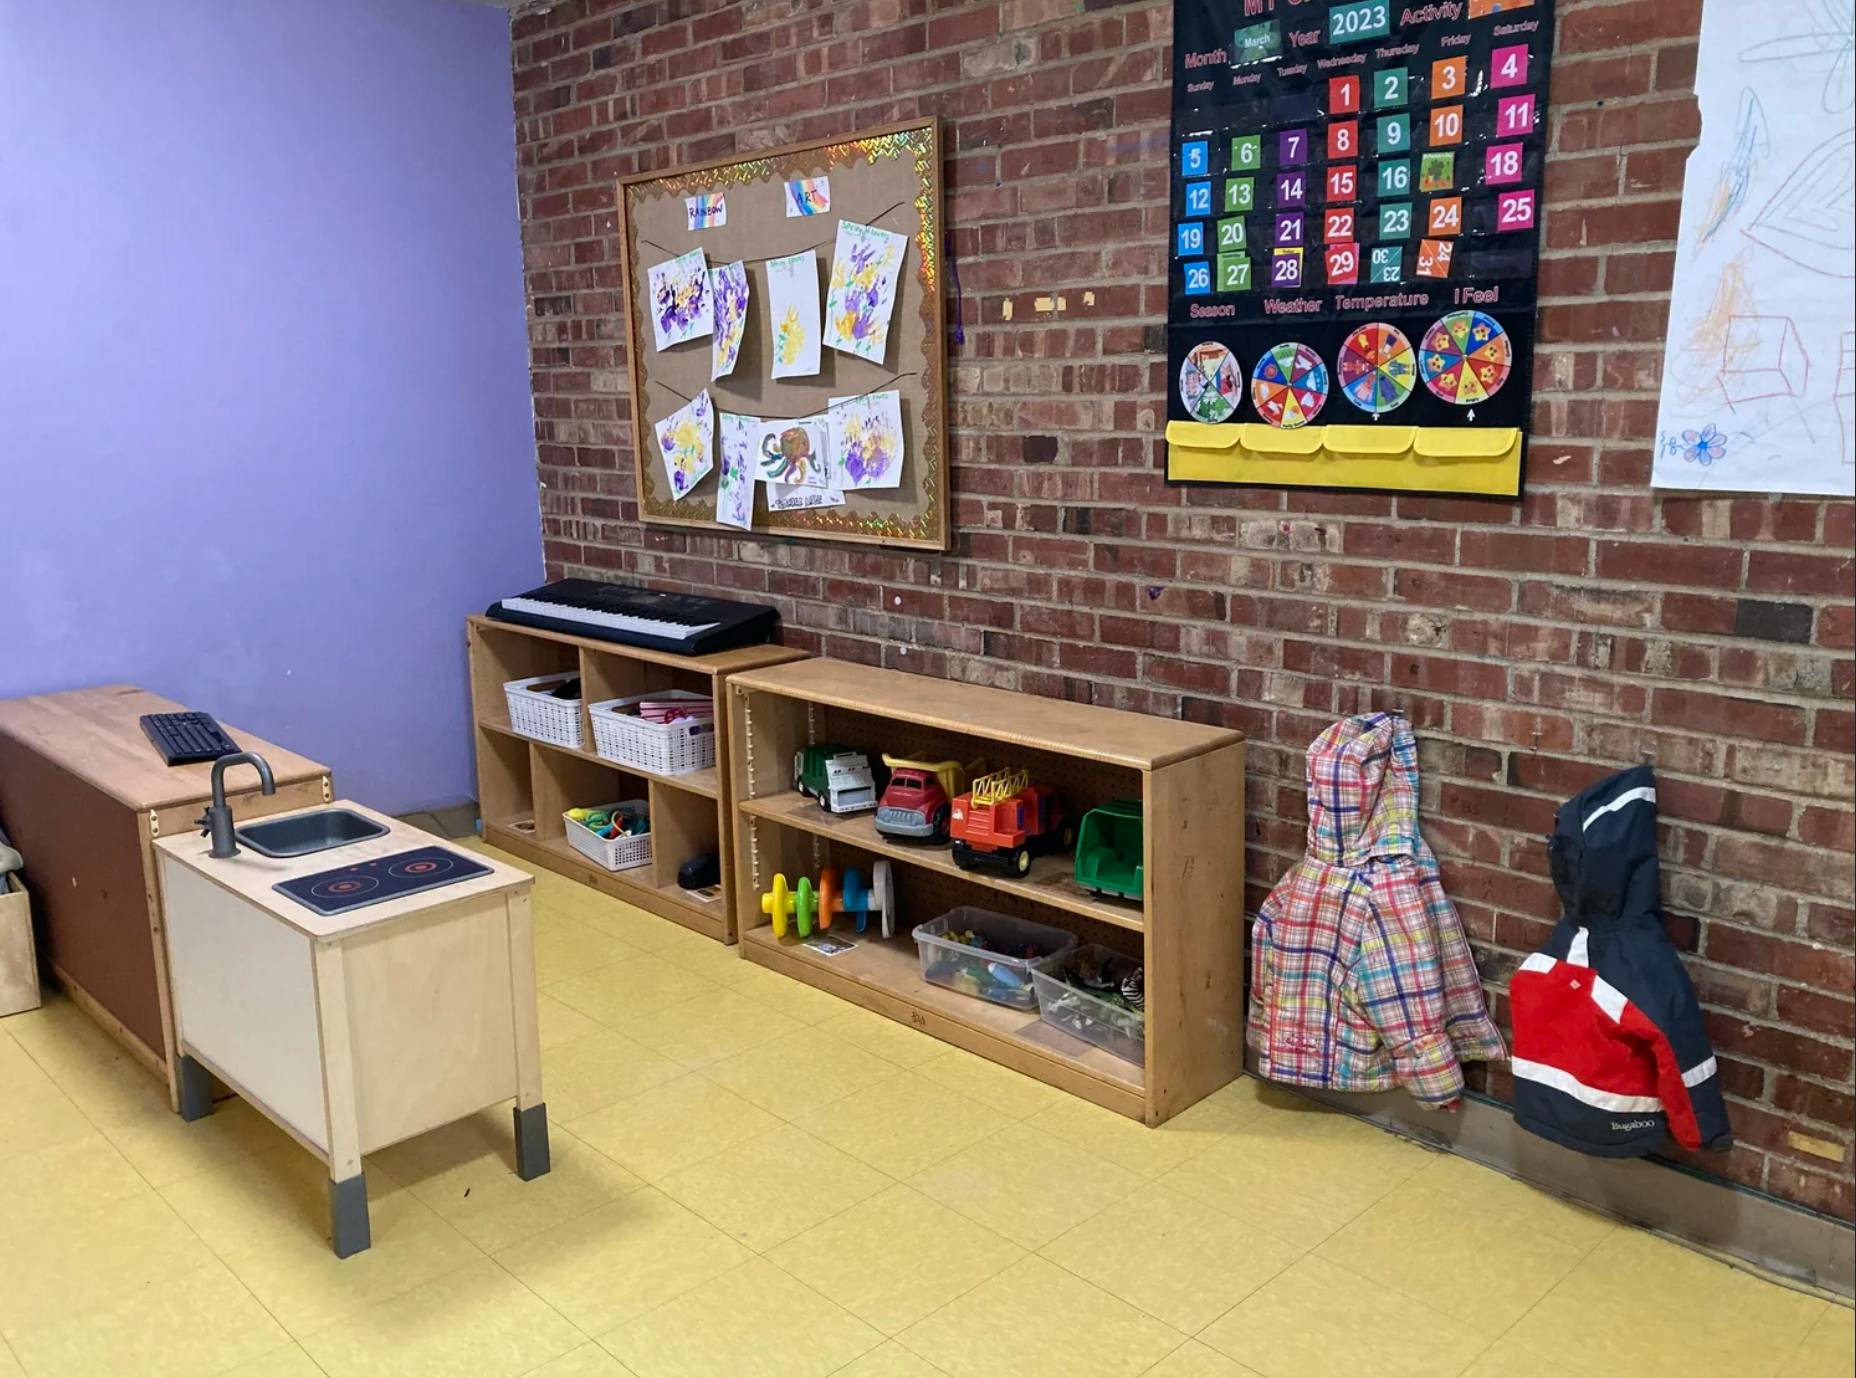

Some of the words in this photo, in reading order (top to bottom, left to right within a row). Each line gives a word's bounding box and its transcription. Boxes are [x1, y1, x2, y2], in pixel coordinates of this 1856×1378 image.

[1332, 6, 1386, 36] 2023
[1400, 2, 1463, 26] Activity
[1244, 34, 1271, 47] March
[1289, 30, 1321, 47] Year
[1185, 49, 1228, 69] Month
[1187, 80, 1215, 93] Sunday
[1232, 72, 1262, 86] Monday
[1277, 63, 1308, 77] Tuesday
[1316, 51, 1367, 70] Wednesday
[1375, 43, 1420, 59] Thursday
[1440, 33, 1472, 47] Friday
[1493, 20, 1539, 37] Saturday
[1340, 83, 1350, 106] 1
[1384, 76, 1399, 101] 2
[1442, 65, 1457, 91] 3
[1500, 53, 1518, 79] 4
[1189, 148, 1202, 169] 5
[1240, 143, 1253, 164] 6
[1288, 136, 1300, 159] 7
[1337, 129, 1350, 151] 8
[1387, 122, 1401, 145] 9
[1434, 112, 1459, 138] 10
[1505, 102, 1529, 129] 11
[1189, 188, 1209, 210] 12
[1228, 184, 1250, 205] 13
[1280, 178, 1303, 201] 14
[1330, 172, 1354, 195] 15
[1382, 165, 1408, 190] 16
[1490, 150, 1519, 177] 18
[796, 189, 818, 206] ART
[689, 203, 723, 219] RAINBOW
[1181, 228, 1201, 249] 19
[1221, 223, 1244, 245] 20
[1279, 219, 1301, 241] 21
[1327, 215, 1353, 238] 22
[1383, 209, 1409, 233] 23
[1432, 204, 1459, 229] 24
[1501, 197, 1532, 223] 25
[1372, 249, 1389, 264] 30
[1437, 242, 1452, 262] 24
[1188, 268, 1209, 289] 26
[1227, 264, 1250, 286] 27
[1275, 259, 1299, 281] 28
[1330, 250, 1355, 276] 29
[1383, 266, 1400, 282] 23
[1416, 256, 1433, 276] 31
[1335, 292, 1429, 312] Temperature
[1454, 288, 1460, 305] I
[1462, 286, 1499, 305] Feel
[1189, 303, 1236, 319] Season
[1264, 298, 1323, 315] Weather
[1610, 1120, 1655, 1132] Bugaboo
